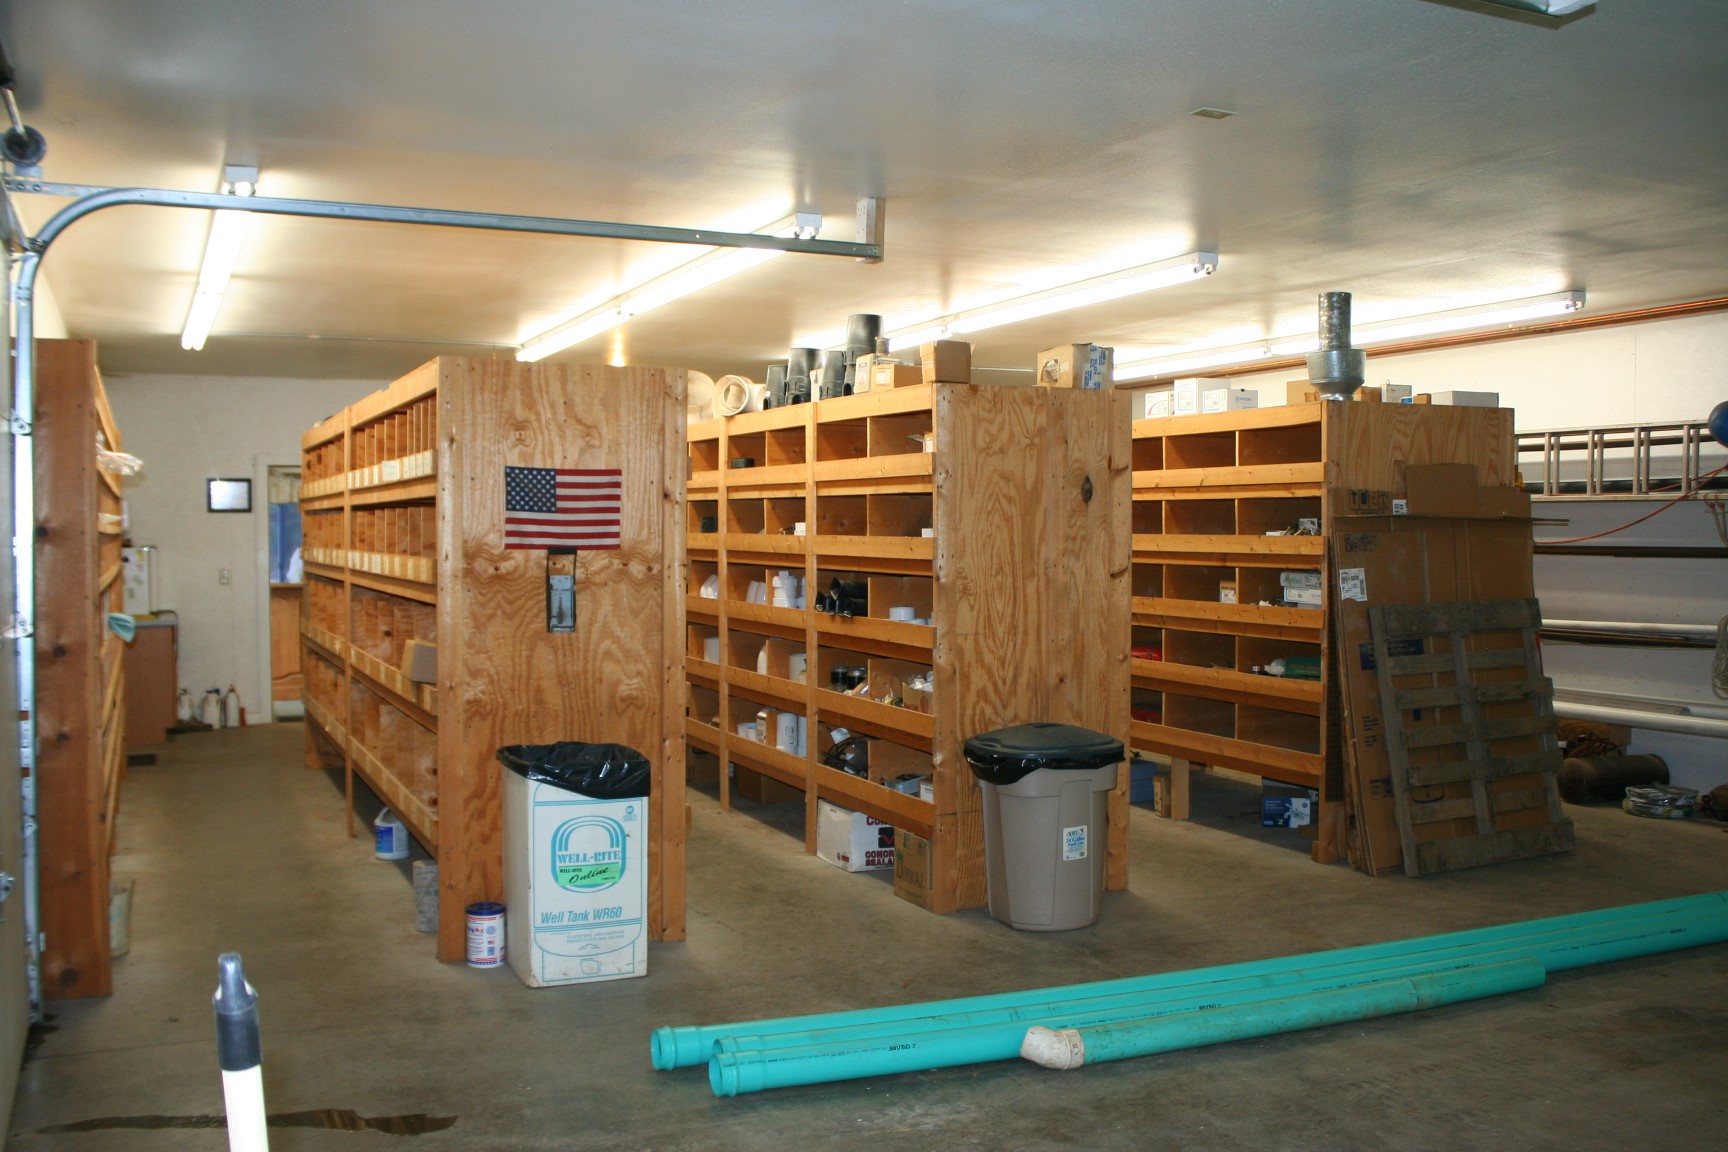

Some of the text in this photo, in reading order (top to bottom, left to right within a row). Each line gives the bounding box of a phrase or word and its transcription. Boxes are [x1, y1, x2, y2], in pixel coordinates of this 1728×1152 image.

[557, 850, 620, 864] WELL-RITE
[568, 867, 609, 884] Online
[541, 906, 623, 924] Well Tank WR60
